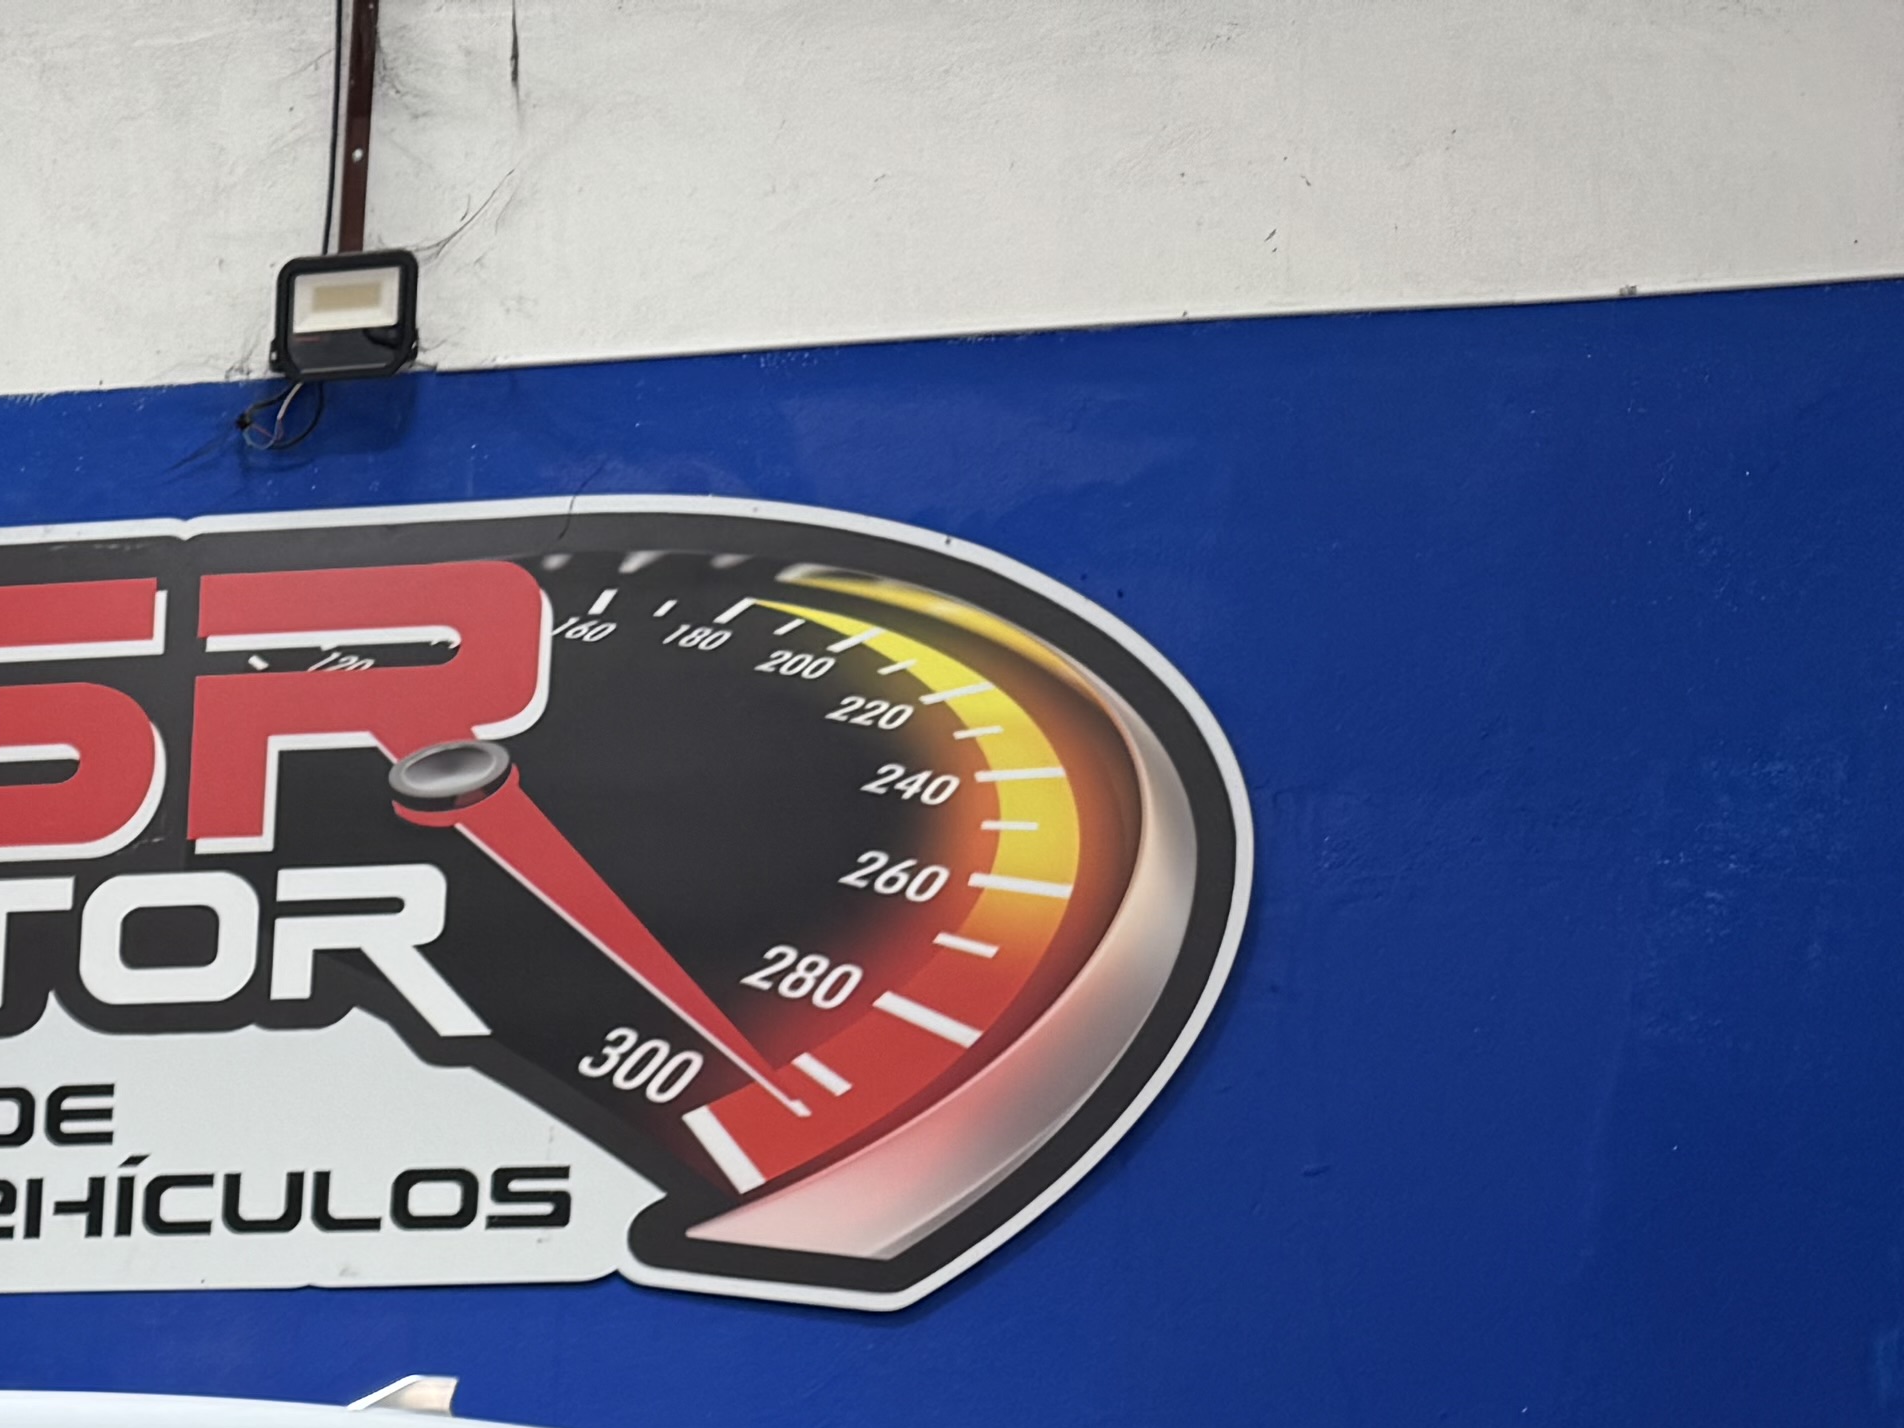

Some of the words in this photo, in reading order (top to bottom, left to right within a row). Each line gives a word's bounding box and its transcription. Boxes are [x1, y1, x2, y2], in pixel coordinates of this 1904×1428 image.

[552, 616, 617, 642] 160
[662, 624, 732, 651] 180
[753, 649, 837, 680] 200
[824, 694, 915, 731] 220
[859, 762, 962, 806] 240
[838, 849, 951, 903] 260
[740, 944, 864, 1010] 280
[577, 1026, 705, 1104] 300
